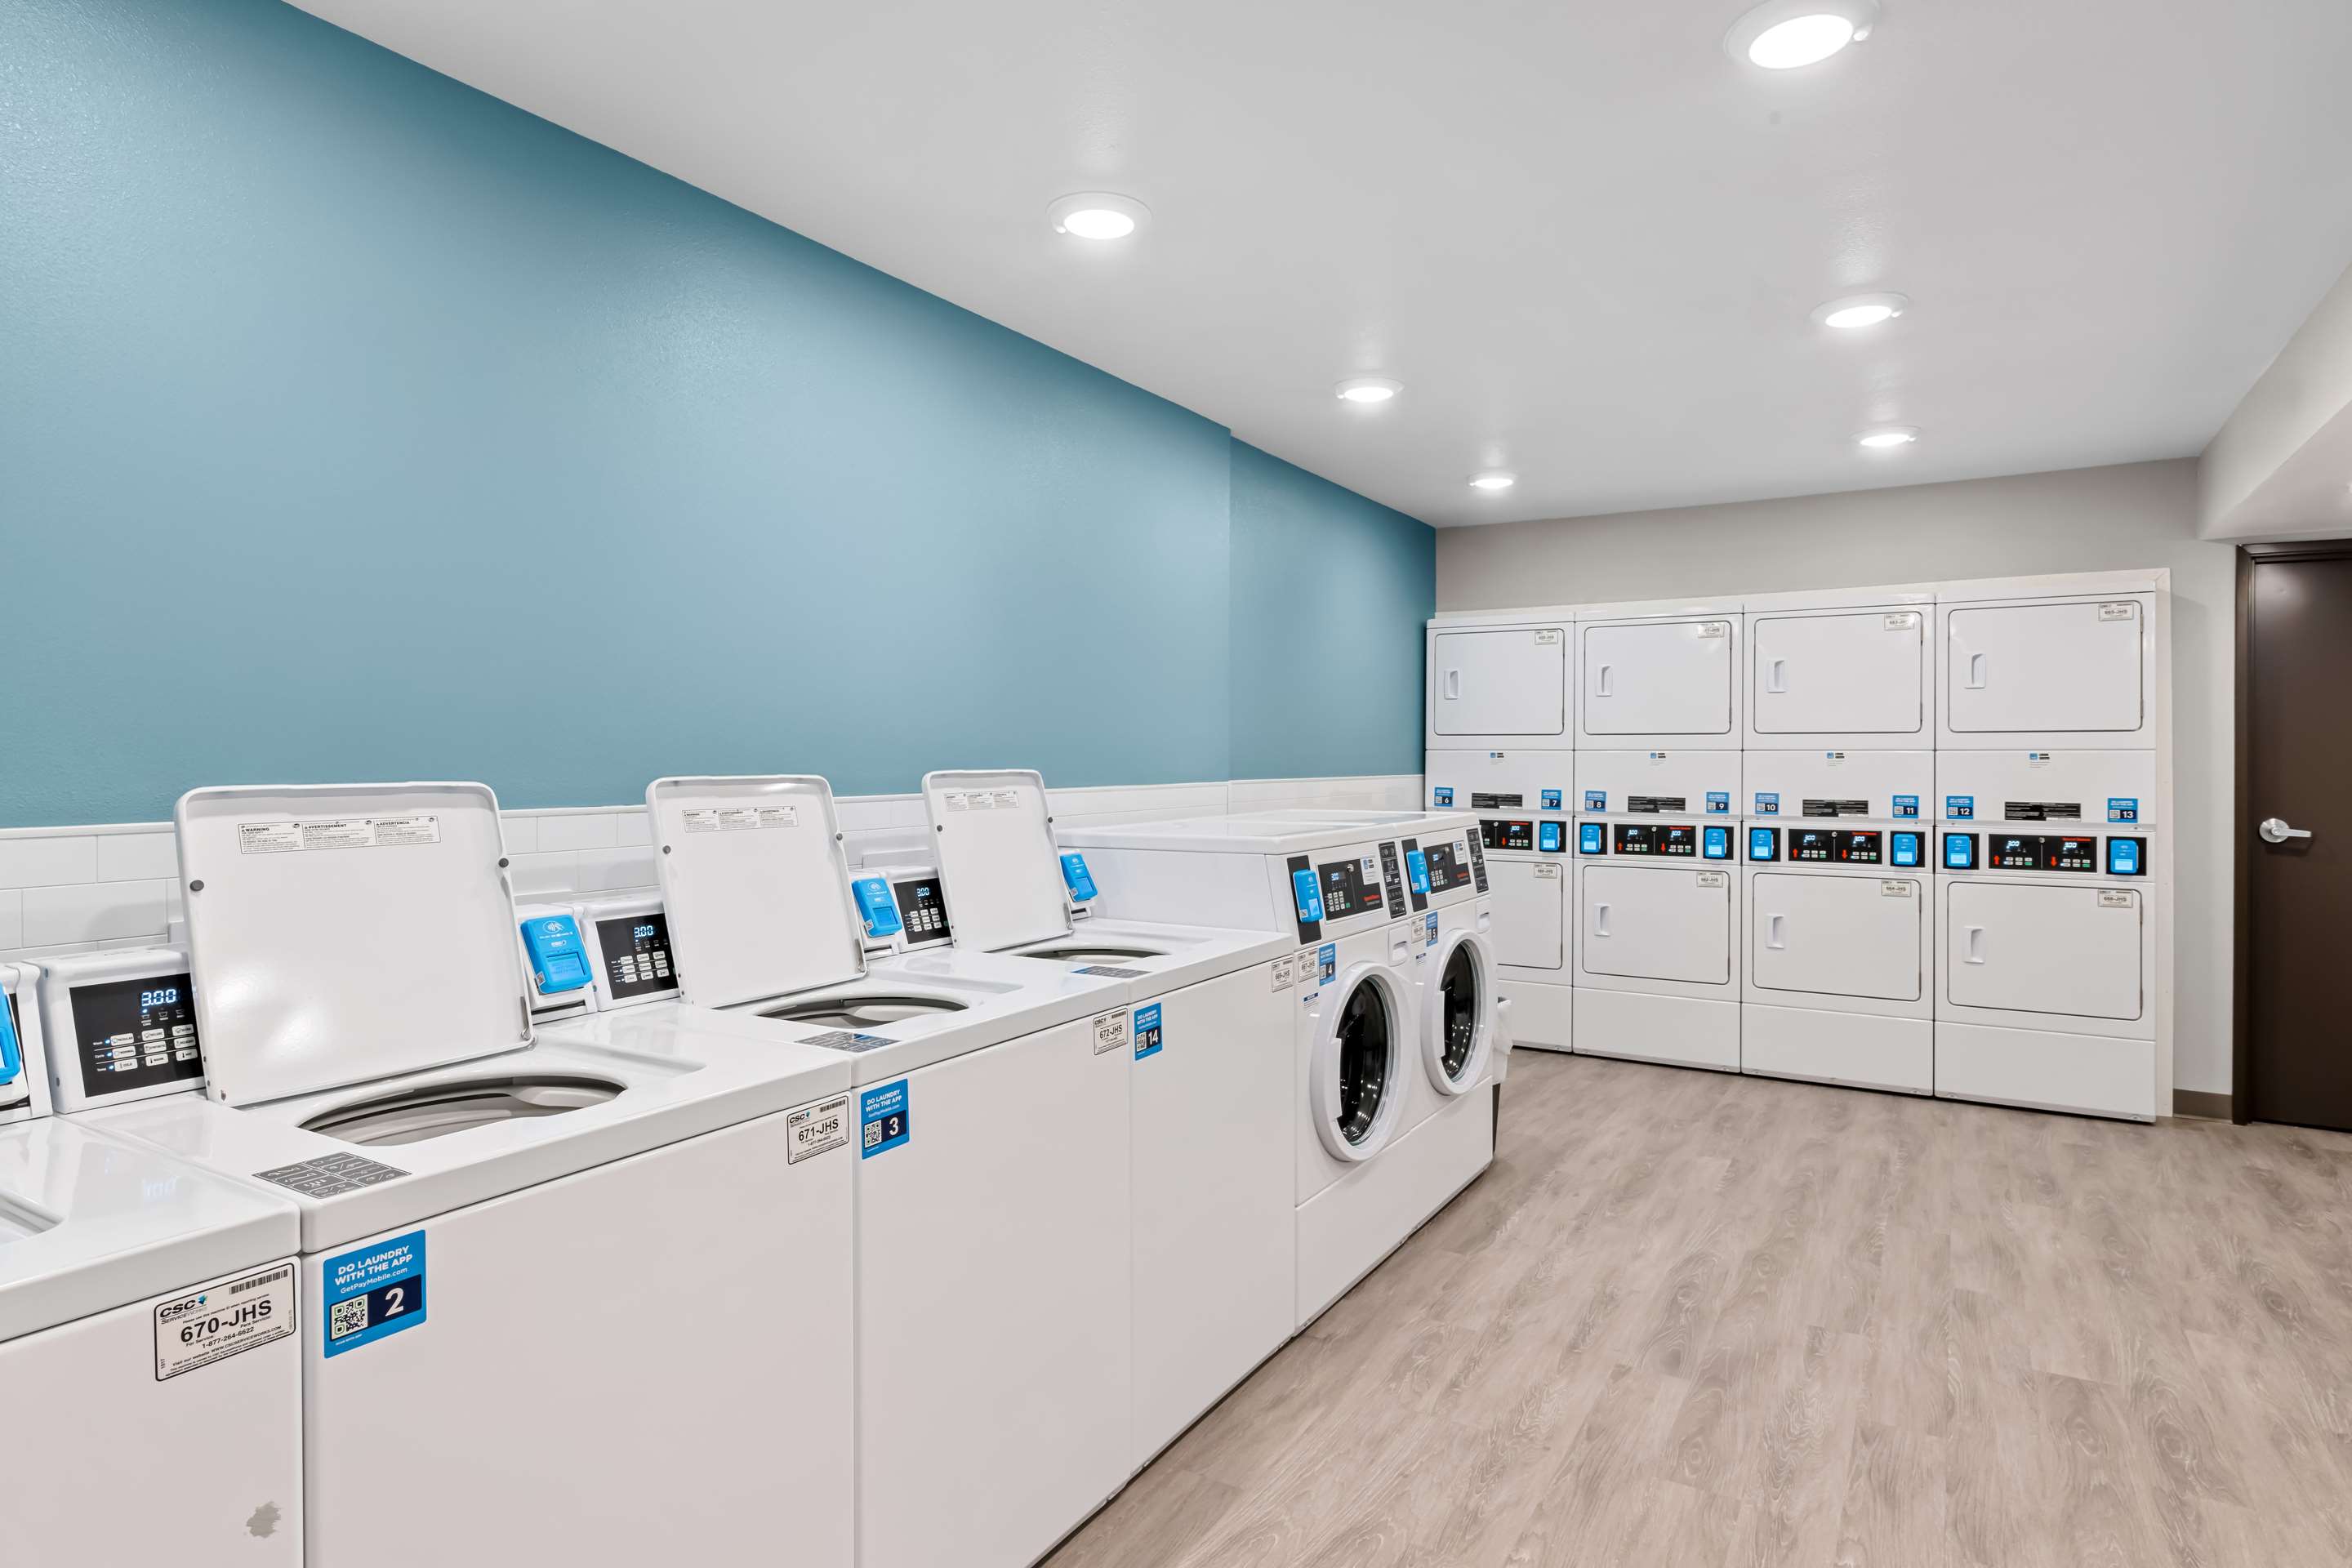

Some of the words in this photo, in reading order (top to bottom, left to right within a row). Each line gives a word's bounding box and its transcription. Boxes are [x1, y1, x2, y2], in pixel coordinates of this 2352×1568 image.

[2123, 810, 2133, 818] 13
[634, 925, 654, 938] 3.00
[1328, 964, 1333, 974] 4
[141, 988, 177, 1007] 3.00
[1099, 1024, 1123, 1040] 672-JHS
[1148, 1029, 1159, 1045] 14
[866, 1103, 880, 1112] WITH
[880, 1099, 891, 1107] THE
[892, 1094, 902, 1103] APP
[875, 1089, 901, 1102] LAUNDRY
[790, 1113, 805, 1124] CSC
[889, 1116, 899, 1136] 3
[798, 1118, 839, 1142] 671-JHS
[334, 1269, 365, 1286] WITH
[368, 1262, 389, 1275] THE
[391, 1254, 413, 1267] APP
[337, 1263, 355, 1276] DO
[358, 1245, 409, 1268] LAUNDRY
[340, 1267, 408, 1294] GetPayMobile.com
[159, 1299, 196, 1318] CSC
[385, 1287, 404, 1317] 2
[180, 1299, 272, 1343] 670-JHS
[202, 1326, 255, 1349] 1-877-264-6622
[192, 1350, 210, 1361] website
